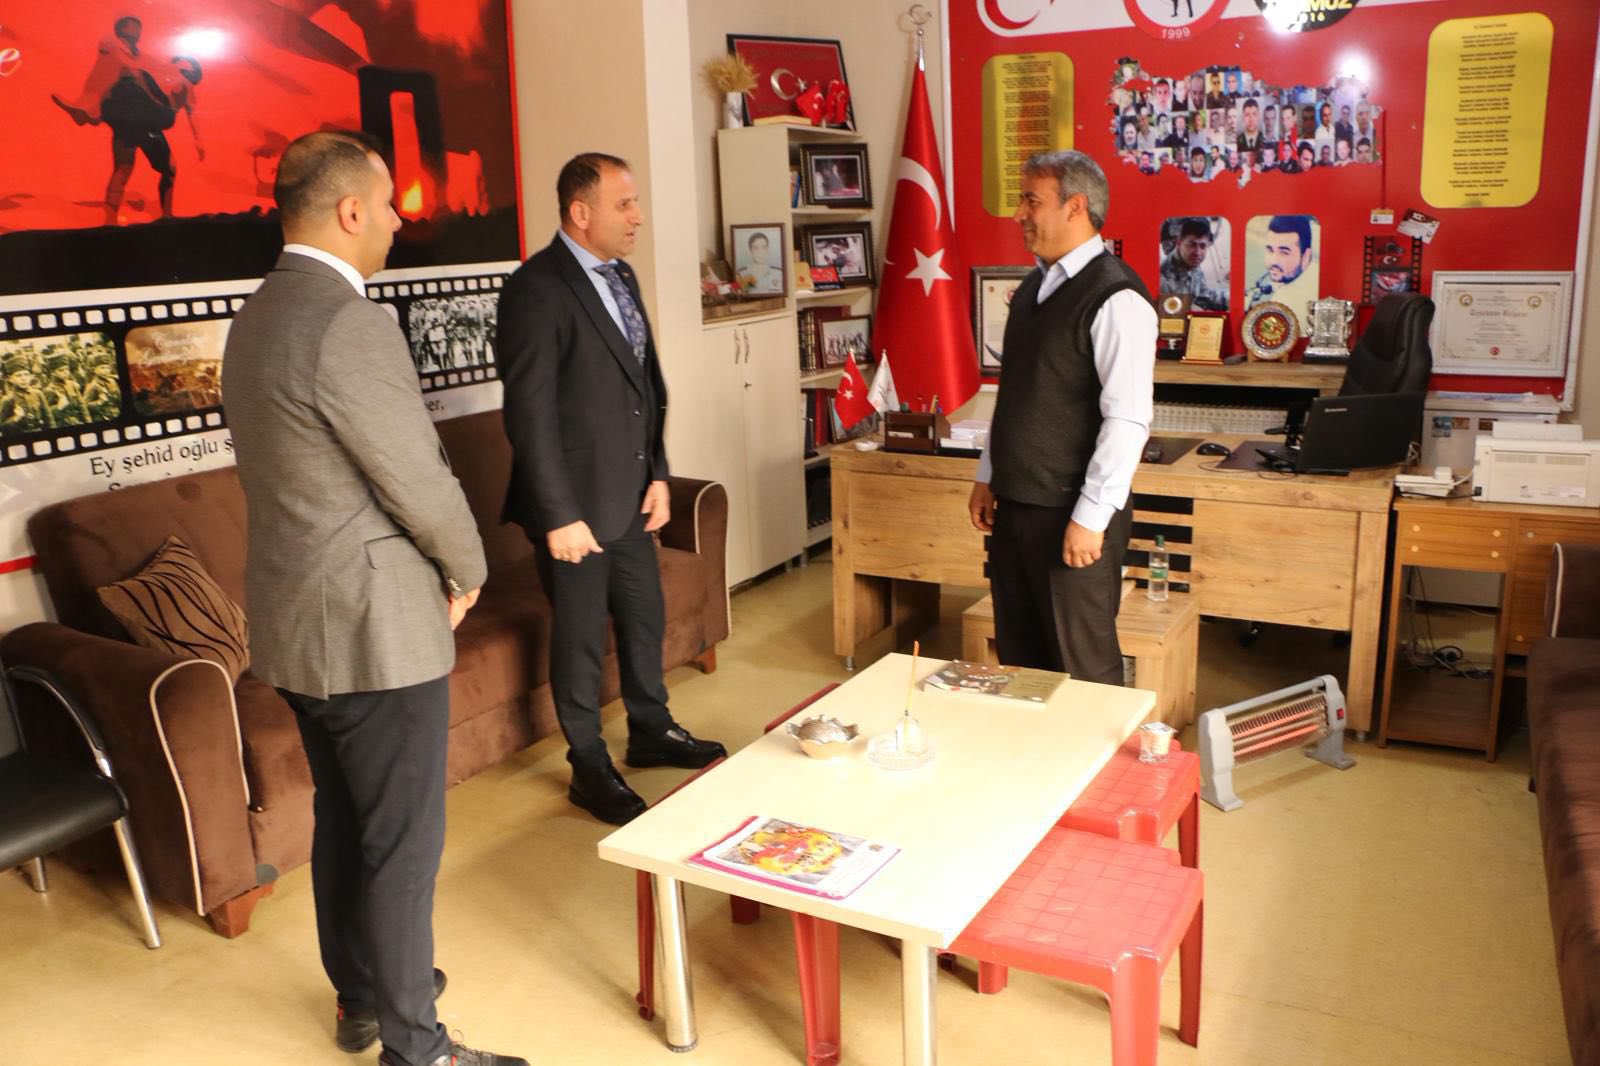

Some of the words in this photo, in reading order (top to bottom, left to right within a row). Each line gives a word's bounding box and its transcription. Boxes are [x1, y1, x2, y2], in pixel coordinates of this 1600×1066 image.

[1162, 26, 1190, 39] 1999
[90, 456, 115, 477] Ey
[179, 438, 218, 461] oğlu
